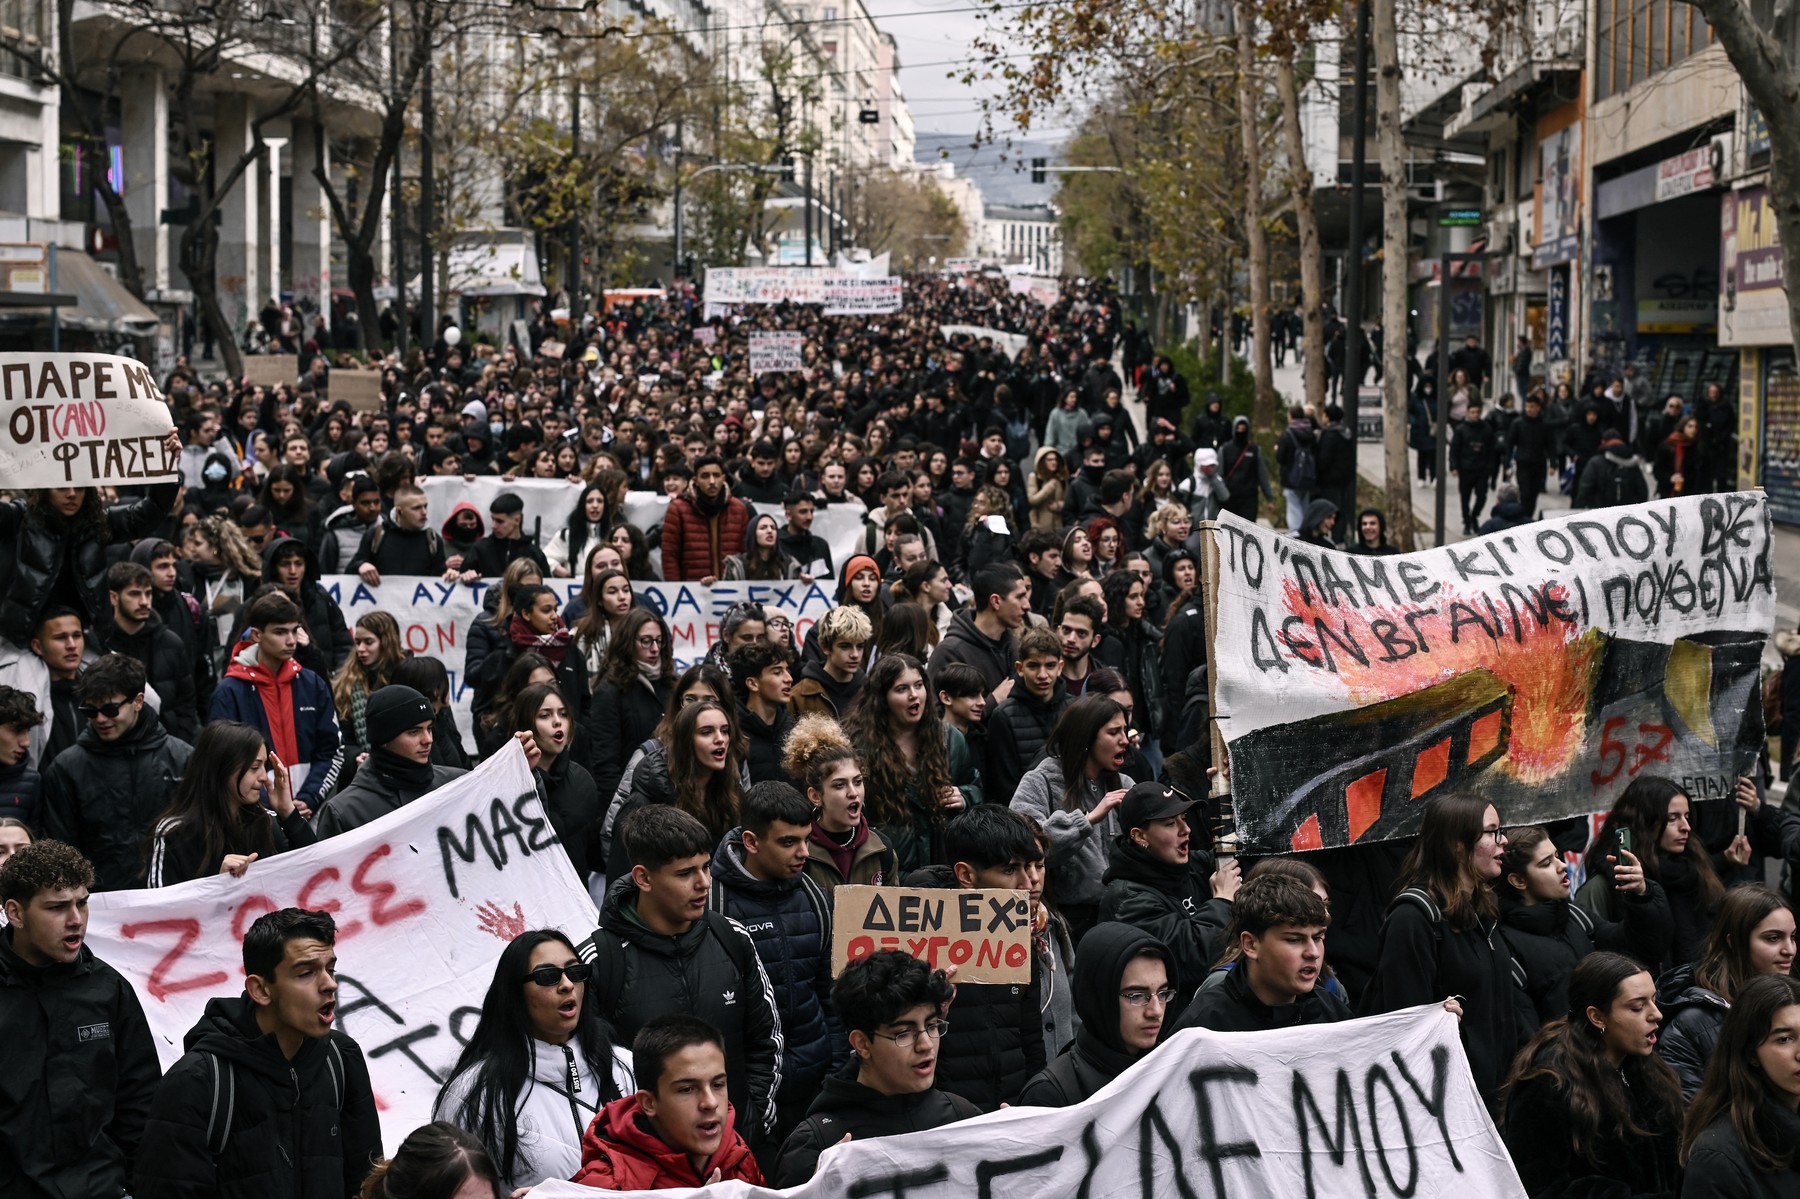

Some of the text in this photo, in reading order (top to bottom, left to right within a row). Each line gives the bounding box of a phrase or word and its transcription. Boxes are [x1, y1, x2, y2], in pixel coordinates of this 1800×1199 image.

[2, 361, 166, 402] ΠΑΡΕ ΜΕ
[9, 400, 106, 445] ΟΤ(ΑΝ)
[1220, 523, 1264, 590] ΤΟ
[1536, 506, 1676, 566] ΟΠΟΥ
[711, 583, 839, 617] ΞΕΧΑ
[1251, 606, 1370, 674] ΔΕΝ
[1600, 553, 1772, 627] ΠΟΥΘΕΝΑ
[1591, 715, 1674, 788] 57
[862, 892, 945, 932] ΔΕΝ
[572, 1077, 580, 1090] JUST
[1292, 1045, 1465, 1199] ΜΟΥ
